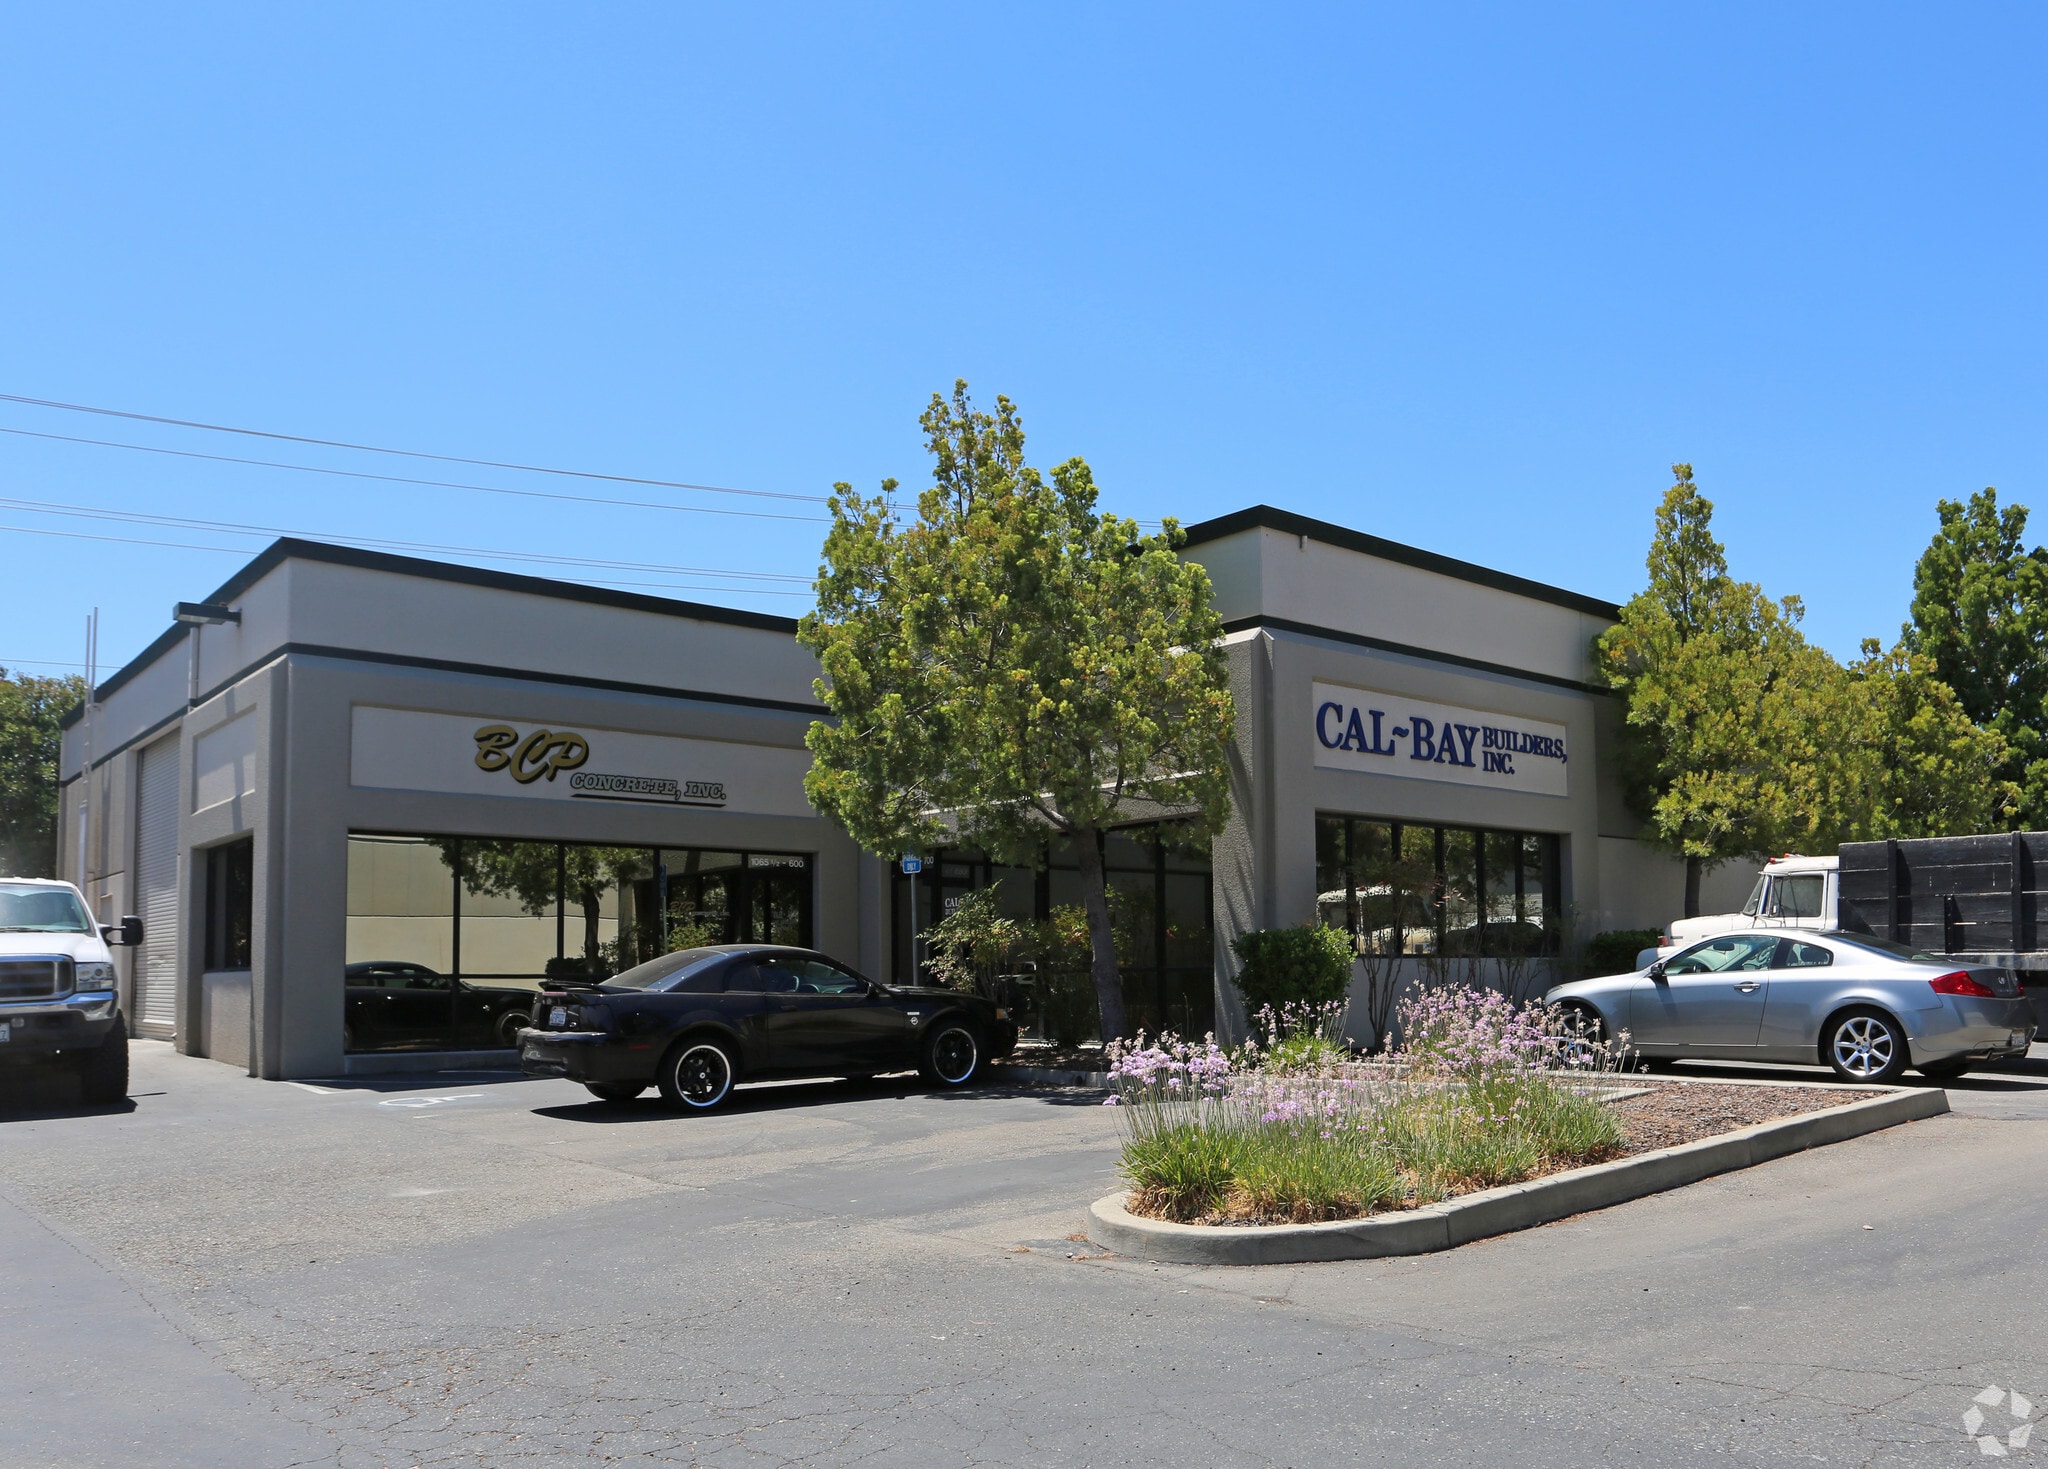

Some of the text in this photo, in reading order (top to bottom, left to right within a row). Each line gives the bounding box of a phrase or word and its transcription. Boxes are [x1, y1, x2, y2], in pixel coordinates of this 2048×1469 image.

[474, 725, 589, 783] BCP
[1482, 726, 1568, 764] BUILDERS,
[1483, 751, 1515, 775] INC.
[570, 772, 727, 800] CONCRETE, INC.
[751, 858, 769, 866] 1065
[788, 859, 804, 868] 600
